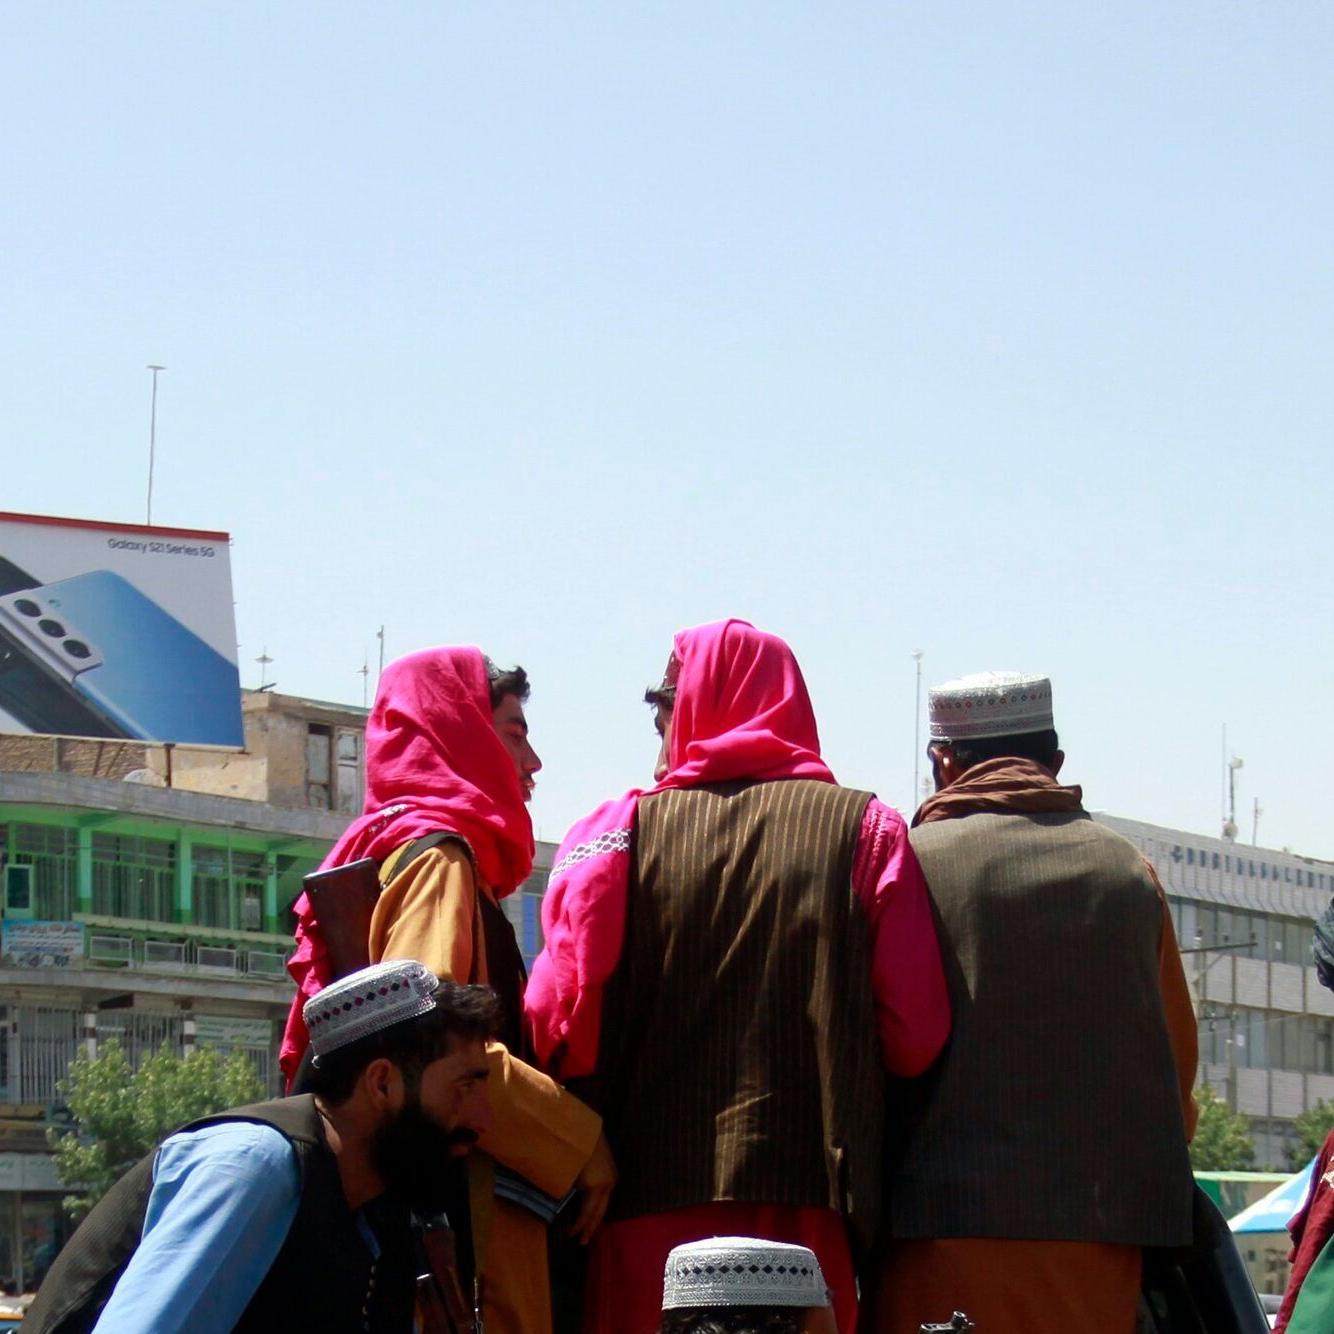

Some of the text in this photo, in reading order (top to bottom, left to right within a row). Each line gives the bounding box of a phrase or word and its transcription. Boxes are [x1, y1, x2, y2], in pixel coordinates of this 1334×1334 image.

[107, 538, 215, 558] Galaxy S21 Series 5G
